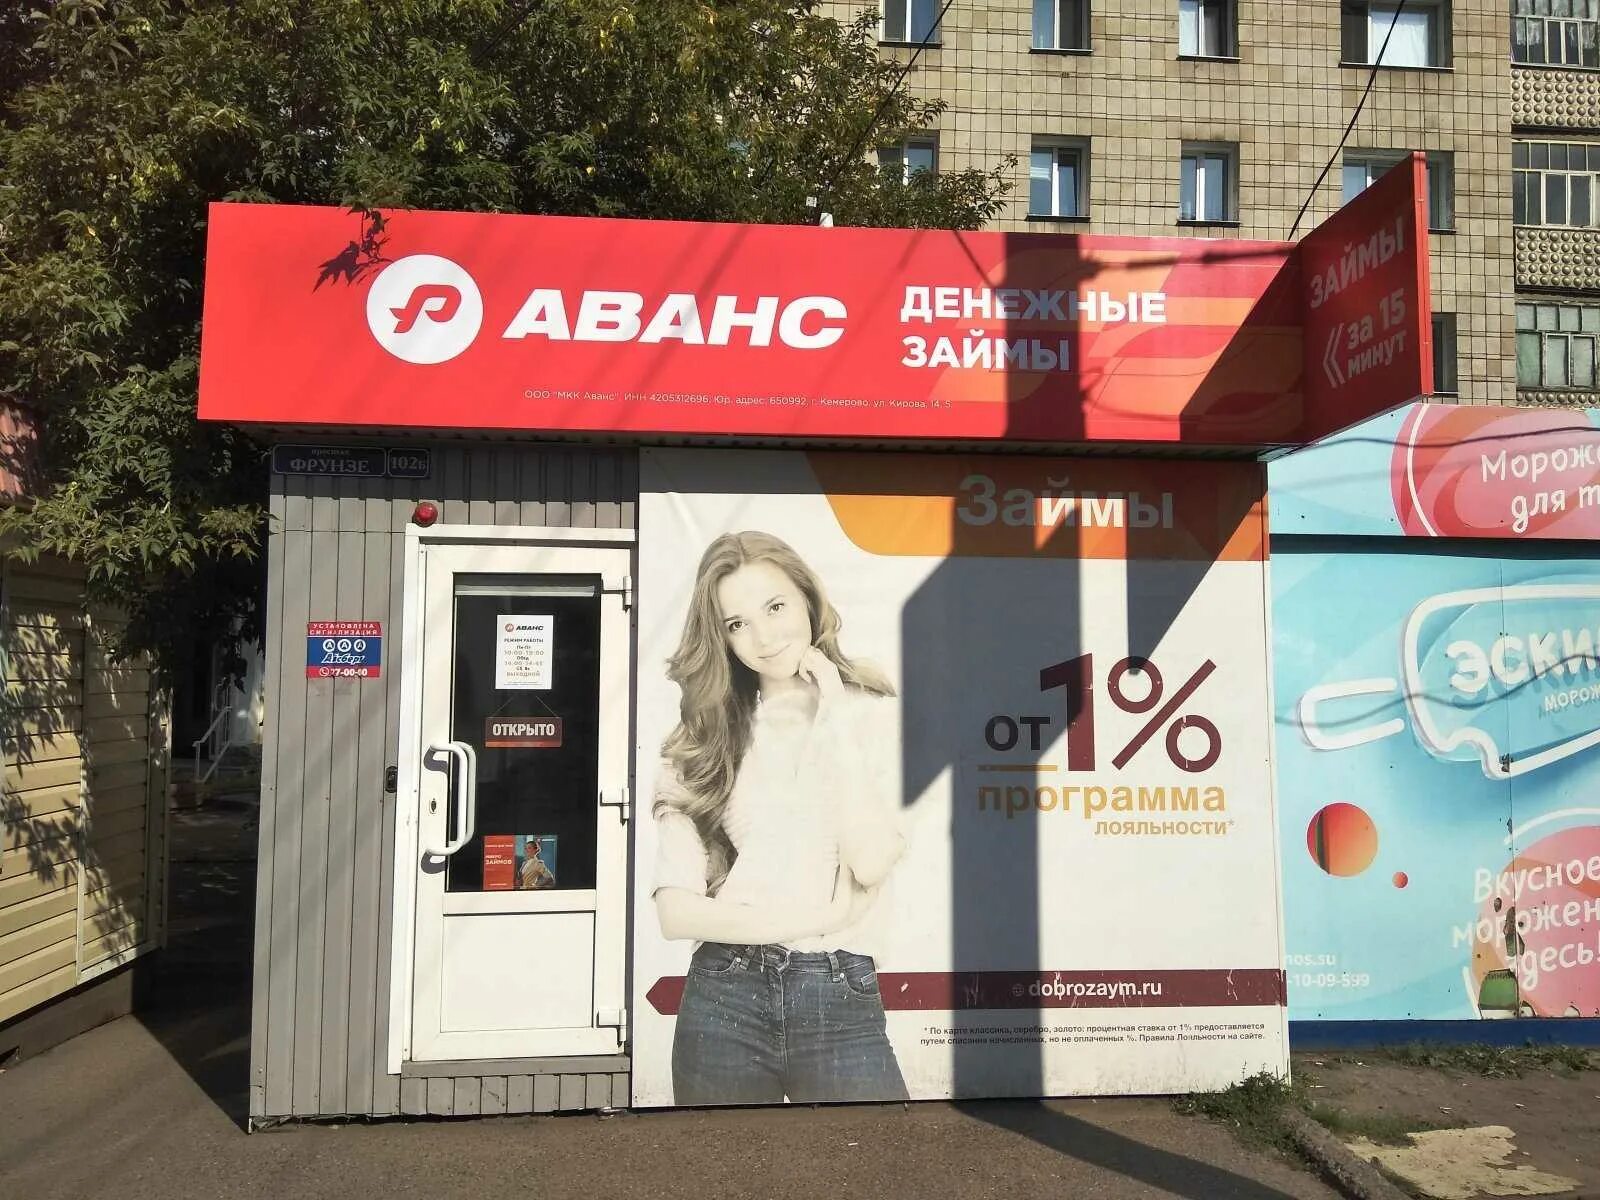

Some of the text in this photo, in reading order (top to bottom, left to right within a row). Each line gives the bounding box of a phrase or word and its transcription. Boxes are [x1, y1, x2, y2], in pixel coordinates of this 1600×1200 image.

[1310, 216, 1405, 308] ЗАЙМЫ
[502, 288, 848, 349] АВАНС
[900, 285, 1168, 324] ДЕНЕЖНЫЕ
[1346, 289, 1406, 350] за 15
[901, 328, 1071, 371] ЗАЙМЫ
[1347, 331, 1407, 378] минут
[524, 389, 550, 400] ООО
[624, 393, 646, 402] ИНН
[290, 458, 370, 474] ФРУНЗЕ
[956, 474, 1174, 528] Займы
[1511, 490, 1566, 534] для
[1445, 628, 1600, 694] ЭСКИ
[492, 723, 556, 736] ОТКРЫТО
[985, 653, 1222, 772] от 1%
[978, 786, 1225, 819] программа
[1473, 855, 1600, 903] Вкусное
[1028, 979, 1162, 999] dobrozaym.ru
[920, 1036, 946, 1046] путем
[947, 1037, 988, 1045] списания
[1073, 1035, 1124, 1043] оплаченных
[1139, 1034, 1175, 1043] Правила
[1227, 1032, 1238, 1040] на
[1239, 1031, 1265, 1040] сайте.
[943, 1027, 968, 1036] карте
[1086, 1024, 1136, 1034] процентная
[1179, 1023, 1193, 1031] 1%
[1194, 1023, 1265, 1032] предоставляется
